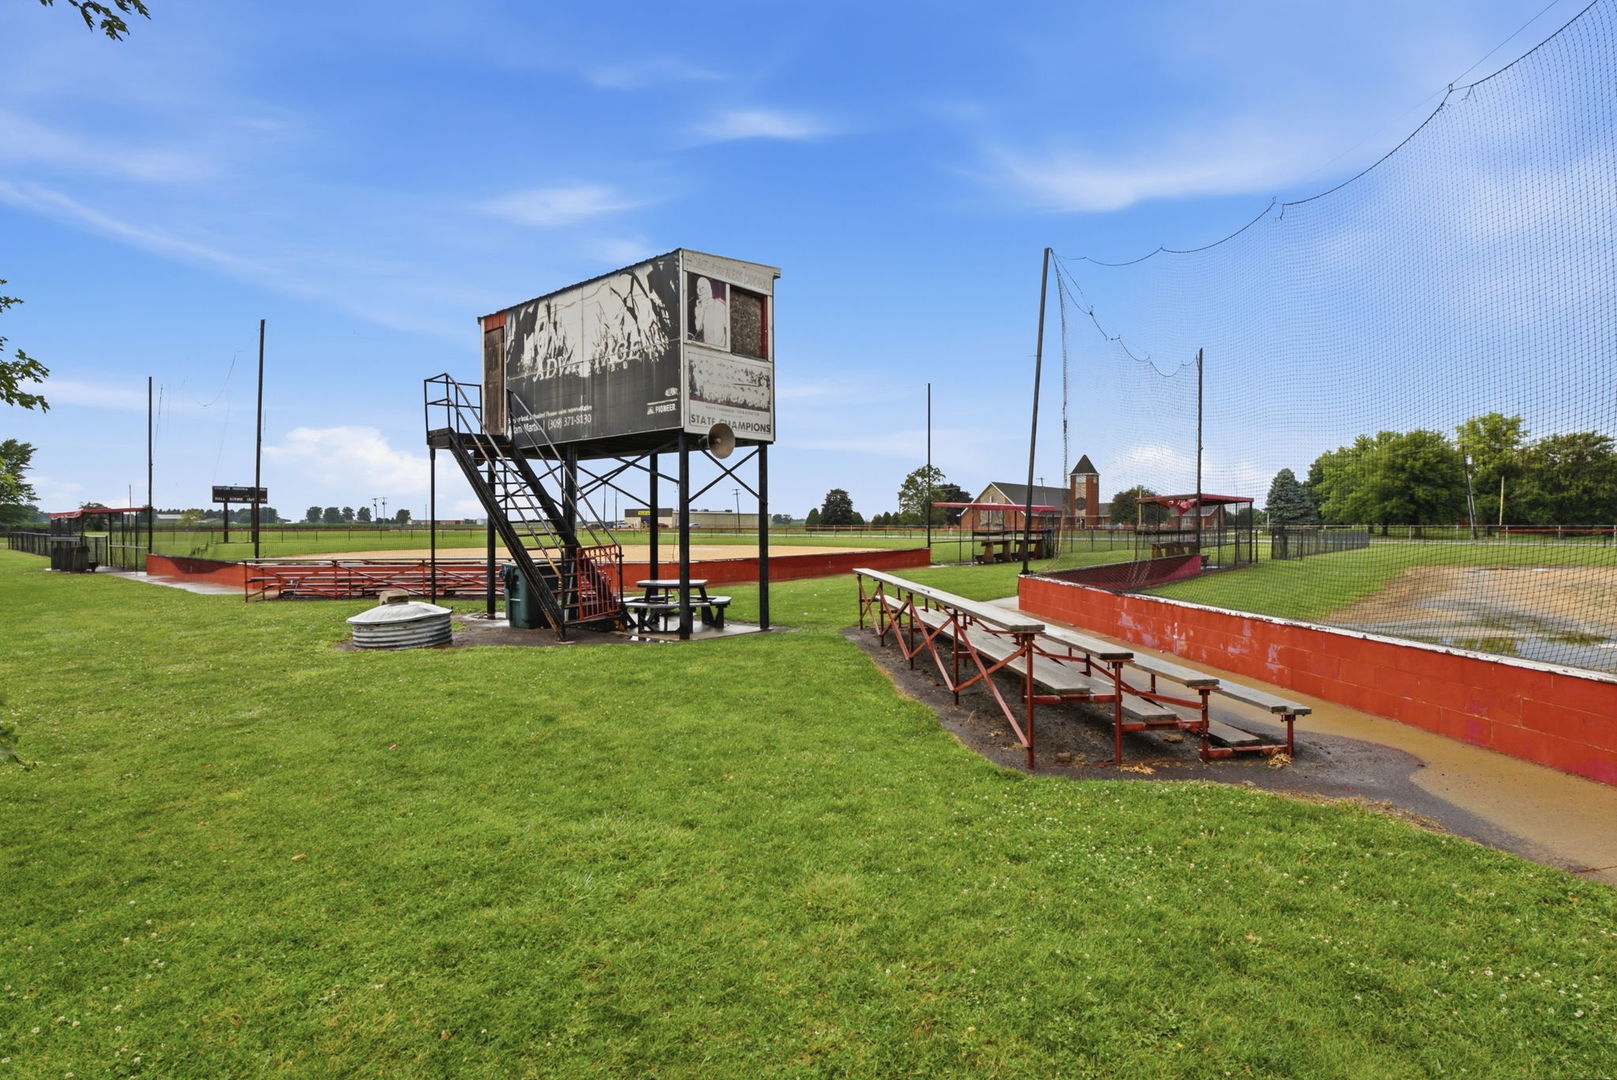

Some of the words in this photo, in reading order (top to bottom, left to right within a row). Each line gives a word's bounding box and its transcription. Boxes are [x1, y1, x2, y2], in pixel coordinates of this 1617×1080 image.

[655, 403, 676, 413] PIONEER
[691, 414, 717, 426] STATE
[718, 418, 771, 433] CHAMPIONS
